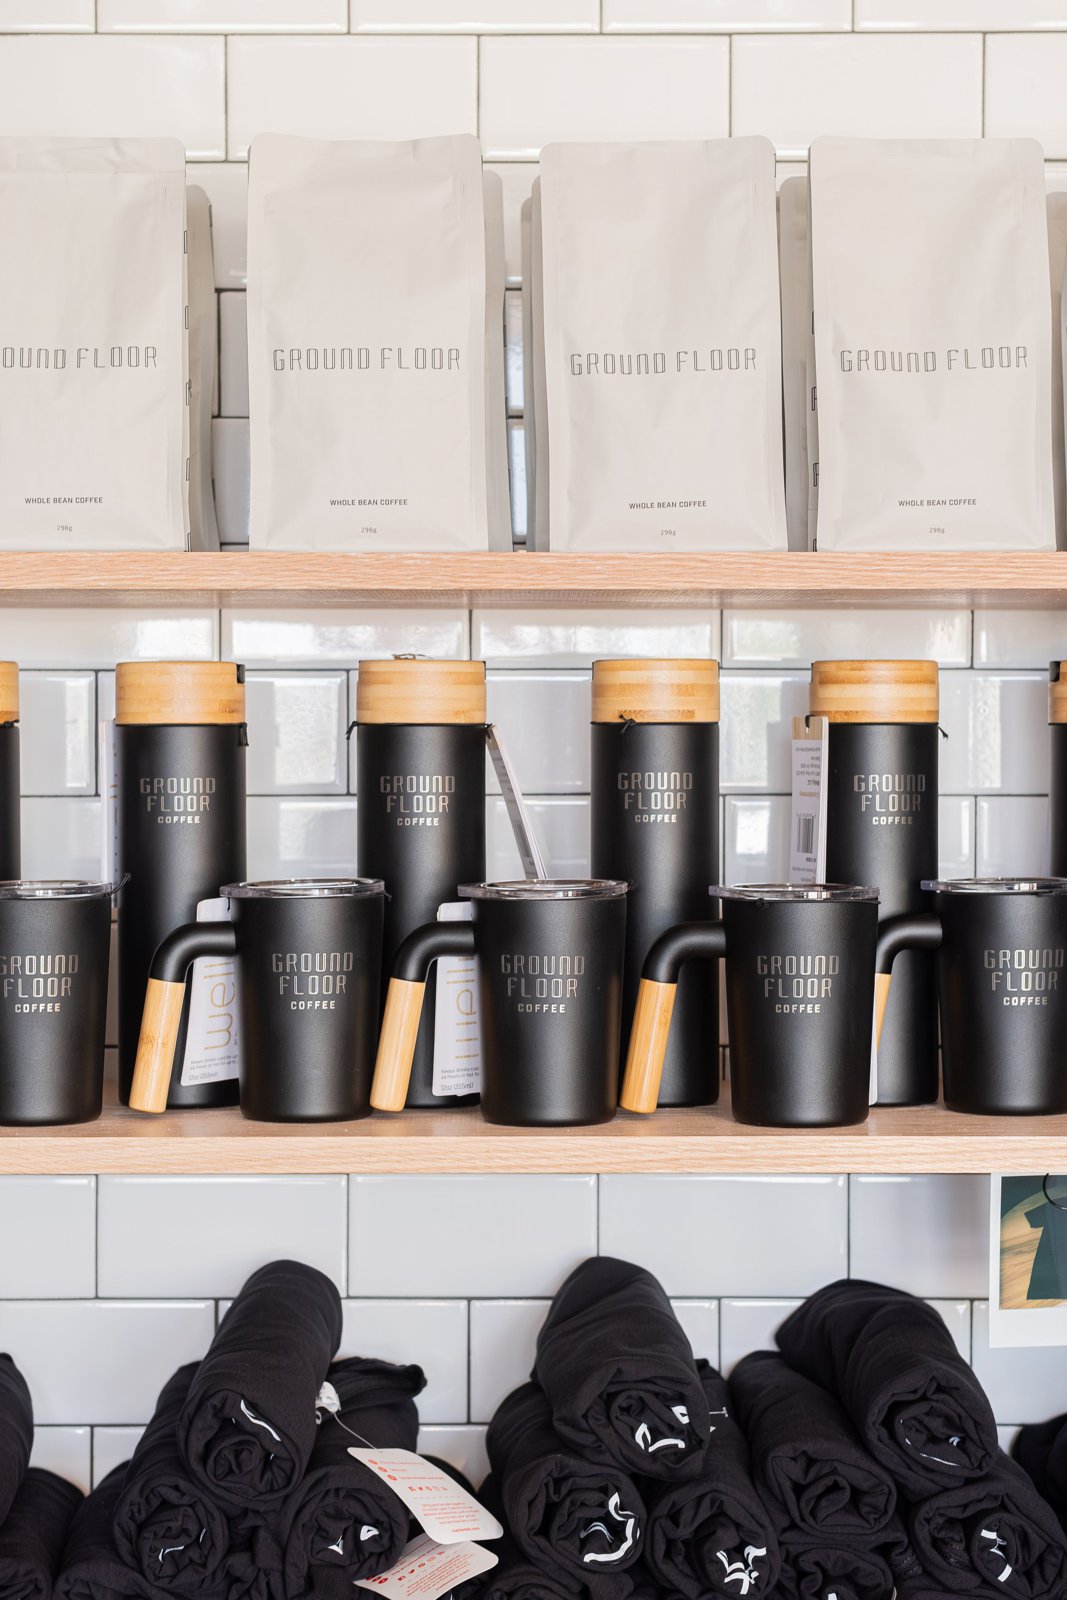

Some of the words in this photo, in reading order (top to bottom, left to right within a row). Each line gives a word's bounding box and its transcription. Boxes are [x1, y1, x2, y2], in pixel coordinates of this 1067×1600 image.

[76, 346, 157, 369] FLOOR
[272, 348, 370, 371] GROUND
[380, 347, 460, 371] FLOOR
[569, 352, 666, 376] GROUND
[676, 348, 757, 373] FLOOR
[840, 349, 937, 373] GROUND
[946, 346, 1028, 370] FLOOR
[75, 496, 103, 504] COFFEE
[380, 498, 408, 506] COFFEE
[656, 501, 677, 509] BEAN
[678, 500, 707, 508] COFFEE
[898, 499, 925, 507] WHOLE
[948, 498, 977, 506] COFFEE
[139, 777, 216, 794] GROUND
[380, 775, 456, 793] GROUND
[617, 771, 693, 790] GROUND
[853, 774, 926, 792] GROUND
[147, 795, 210, 812] FLOOR
[387, 794, 449, 813] FLOOR
[624, 791, 687, 810] FLOOR
[861, 793, 921, 812] FLOOR
[157, 815, 201, 824] COFFEE
[397, 817, 440, 827] COFFEE
[634, 813, 678, 823] COFFEE
[872, 816, 913, 825] COFFEE
[272, 952, 354, 973] GROUND
[501, 954, 585, 976] GROUND
[757, 955, 840, 976] GROUND
[983, 949, 1065, 969] GROUND
[3, 977, 72, 998] FLOOR
[279, 974, 347, 996] FLOOR
[507, 976, 578, 998] FLOOR
[764, 977, 832, 999] FLOOR
[991, 971, 1057, 992] FLOOR
[15, 1002, 61, 1013] COFFEE
[290, 1000, 336, 1010] COFFEE
[517, 1003, 566, 1014] COFFEE
[775, 1003, 821, 1014] COFFEE
[1003, 996, 1048, 1006] COFFEE
